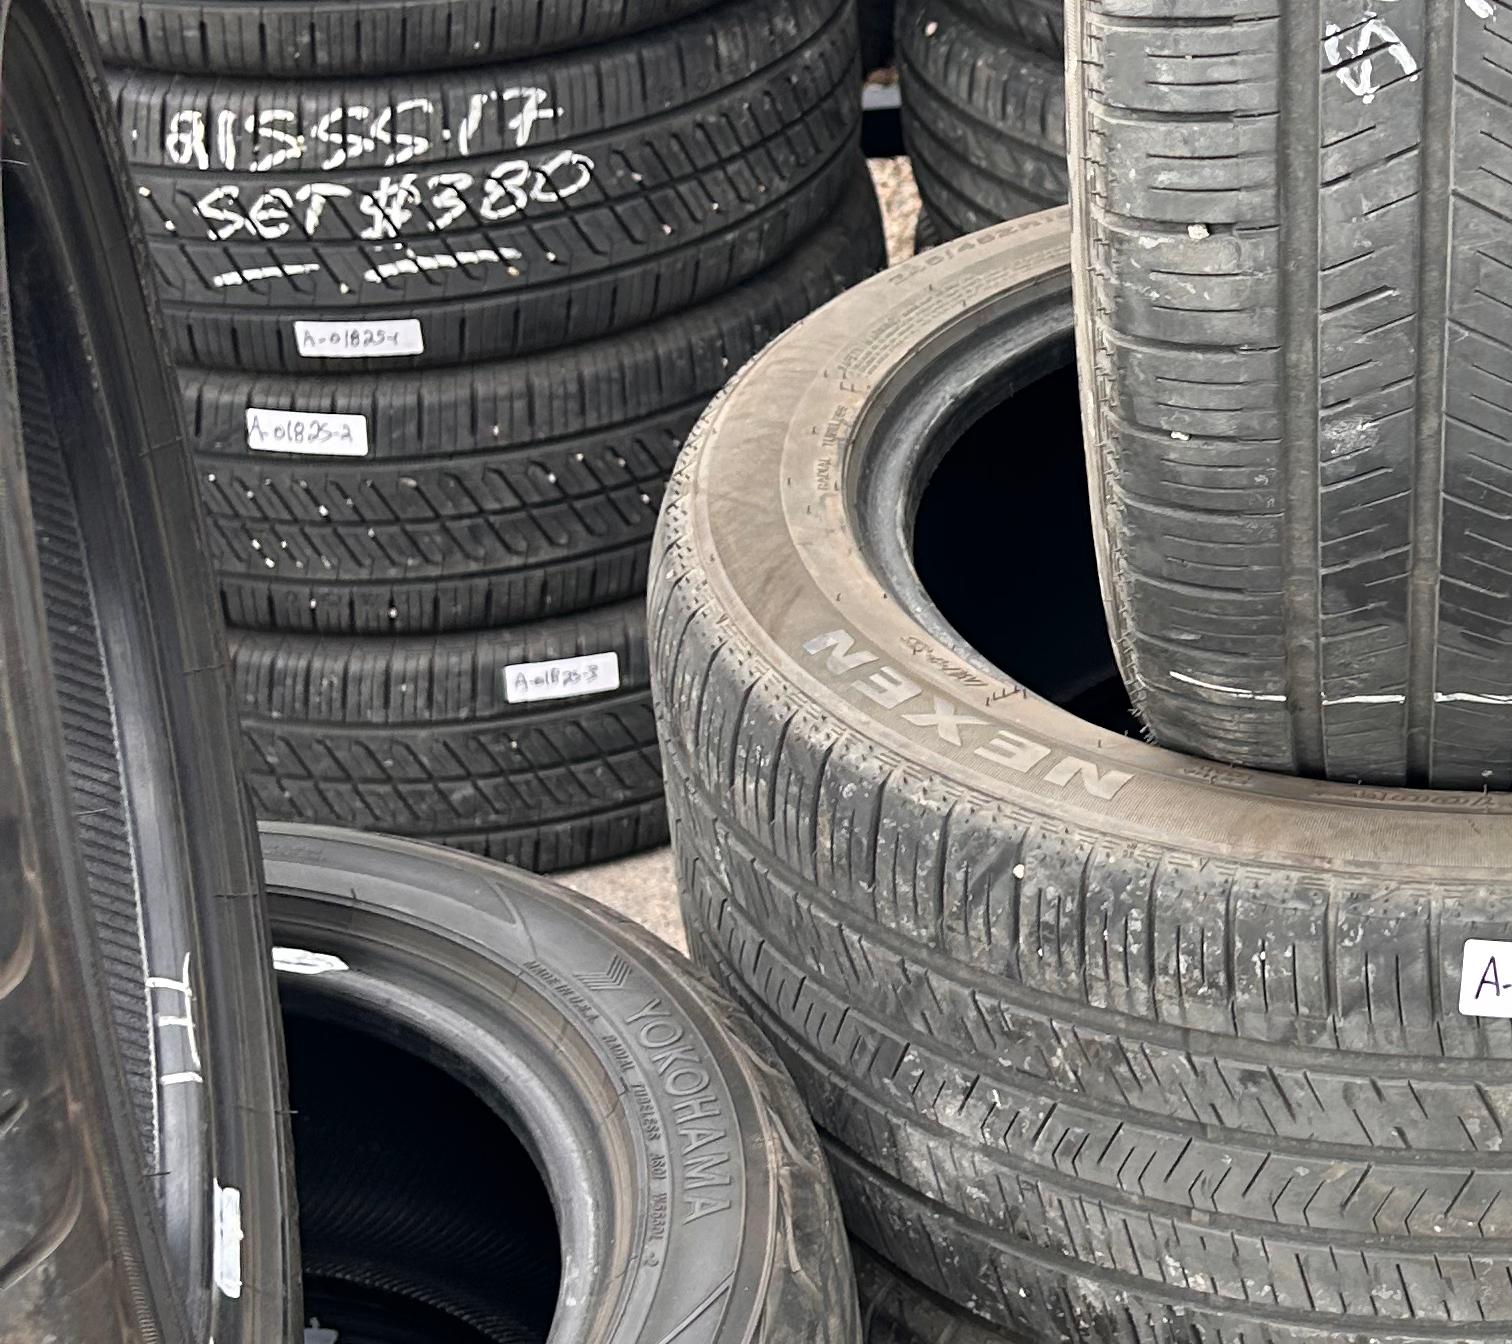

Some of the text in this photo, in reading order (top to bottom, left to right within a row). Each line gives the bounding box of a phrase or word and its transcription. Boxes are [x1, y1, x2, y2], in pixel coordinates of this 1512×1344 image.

[194, 183, 353, 241] SET
[803, 628, 1137, 802] NEXEN
[623, 998, 732, 1226] YOKOHAMA
